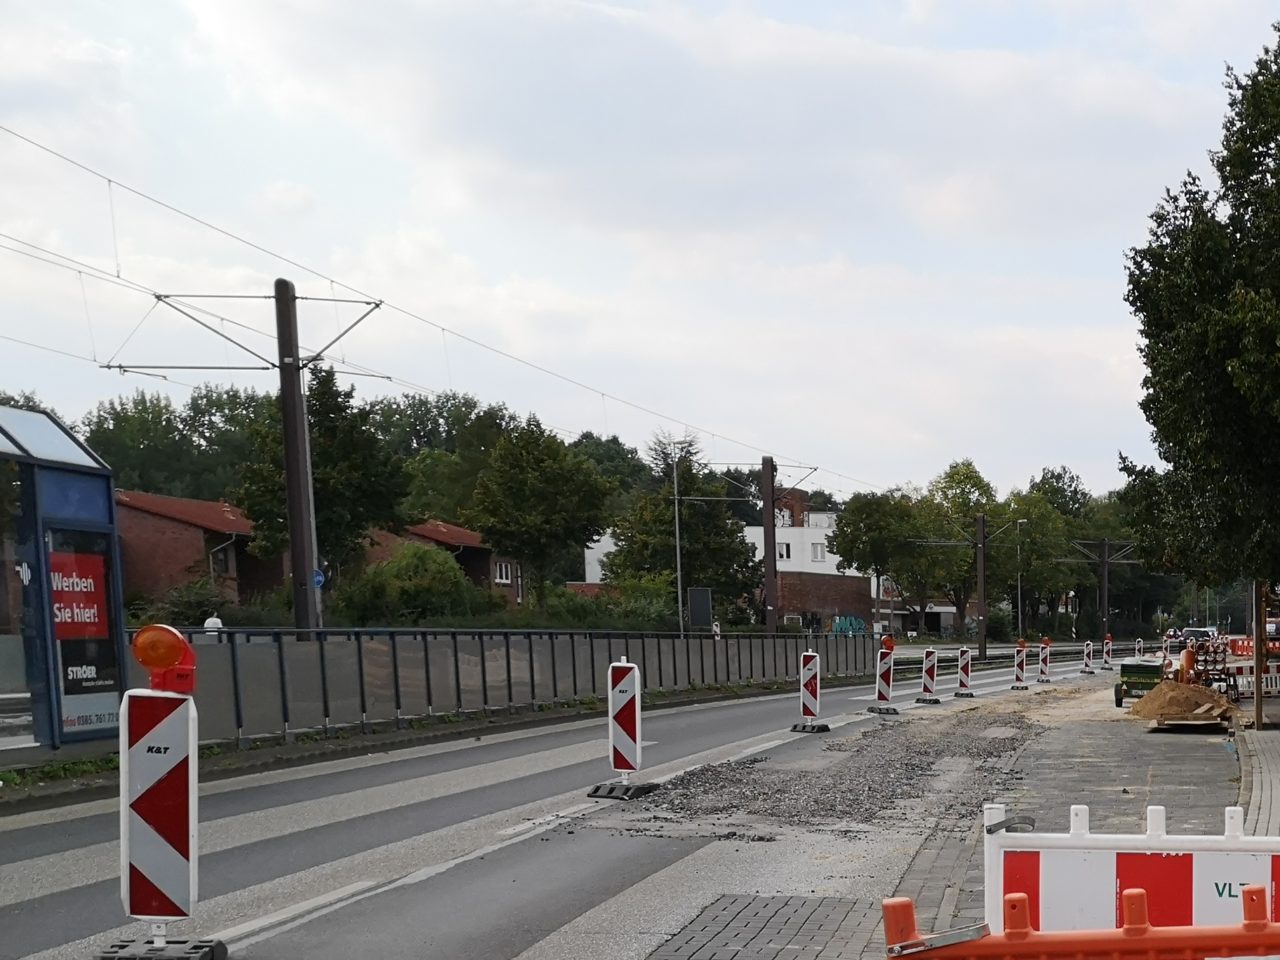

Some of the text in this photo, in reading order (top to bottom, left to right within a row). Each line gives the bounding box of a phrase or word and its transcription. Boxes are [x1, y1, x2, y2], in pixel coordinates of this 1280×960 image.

[50, 572, 95, 592] Werben
[53, 602, 99, 623] Sie hier!
[67, 664, 97, 680] STRÖER
[146, 746, 170, 755] K&T
[1214, 882, 1250, 898] VL
